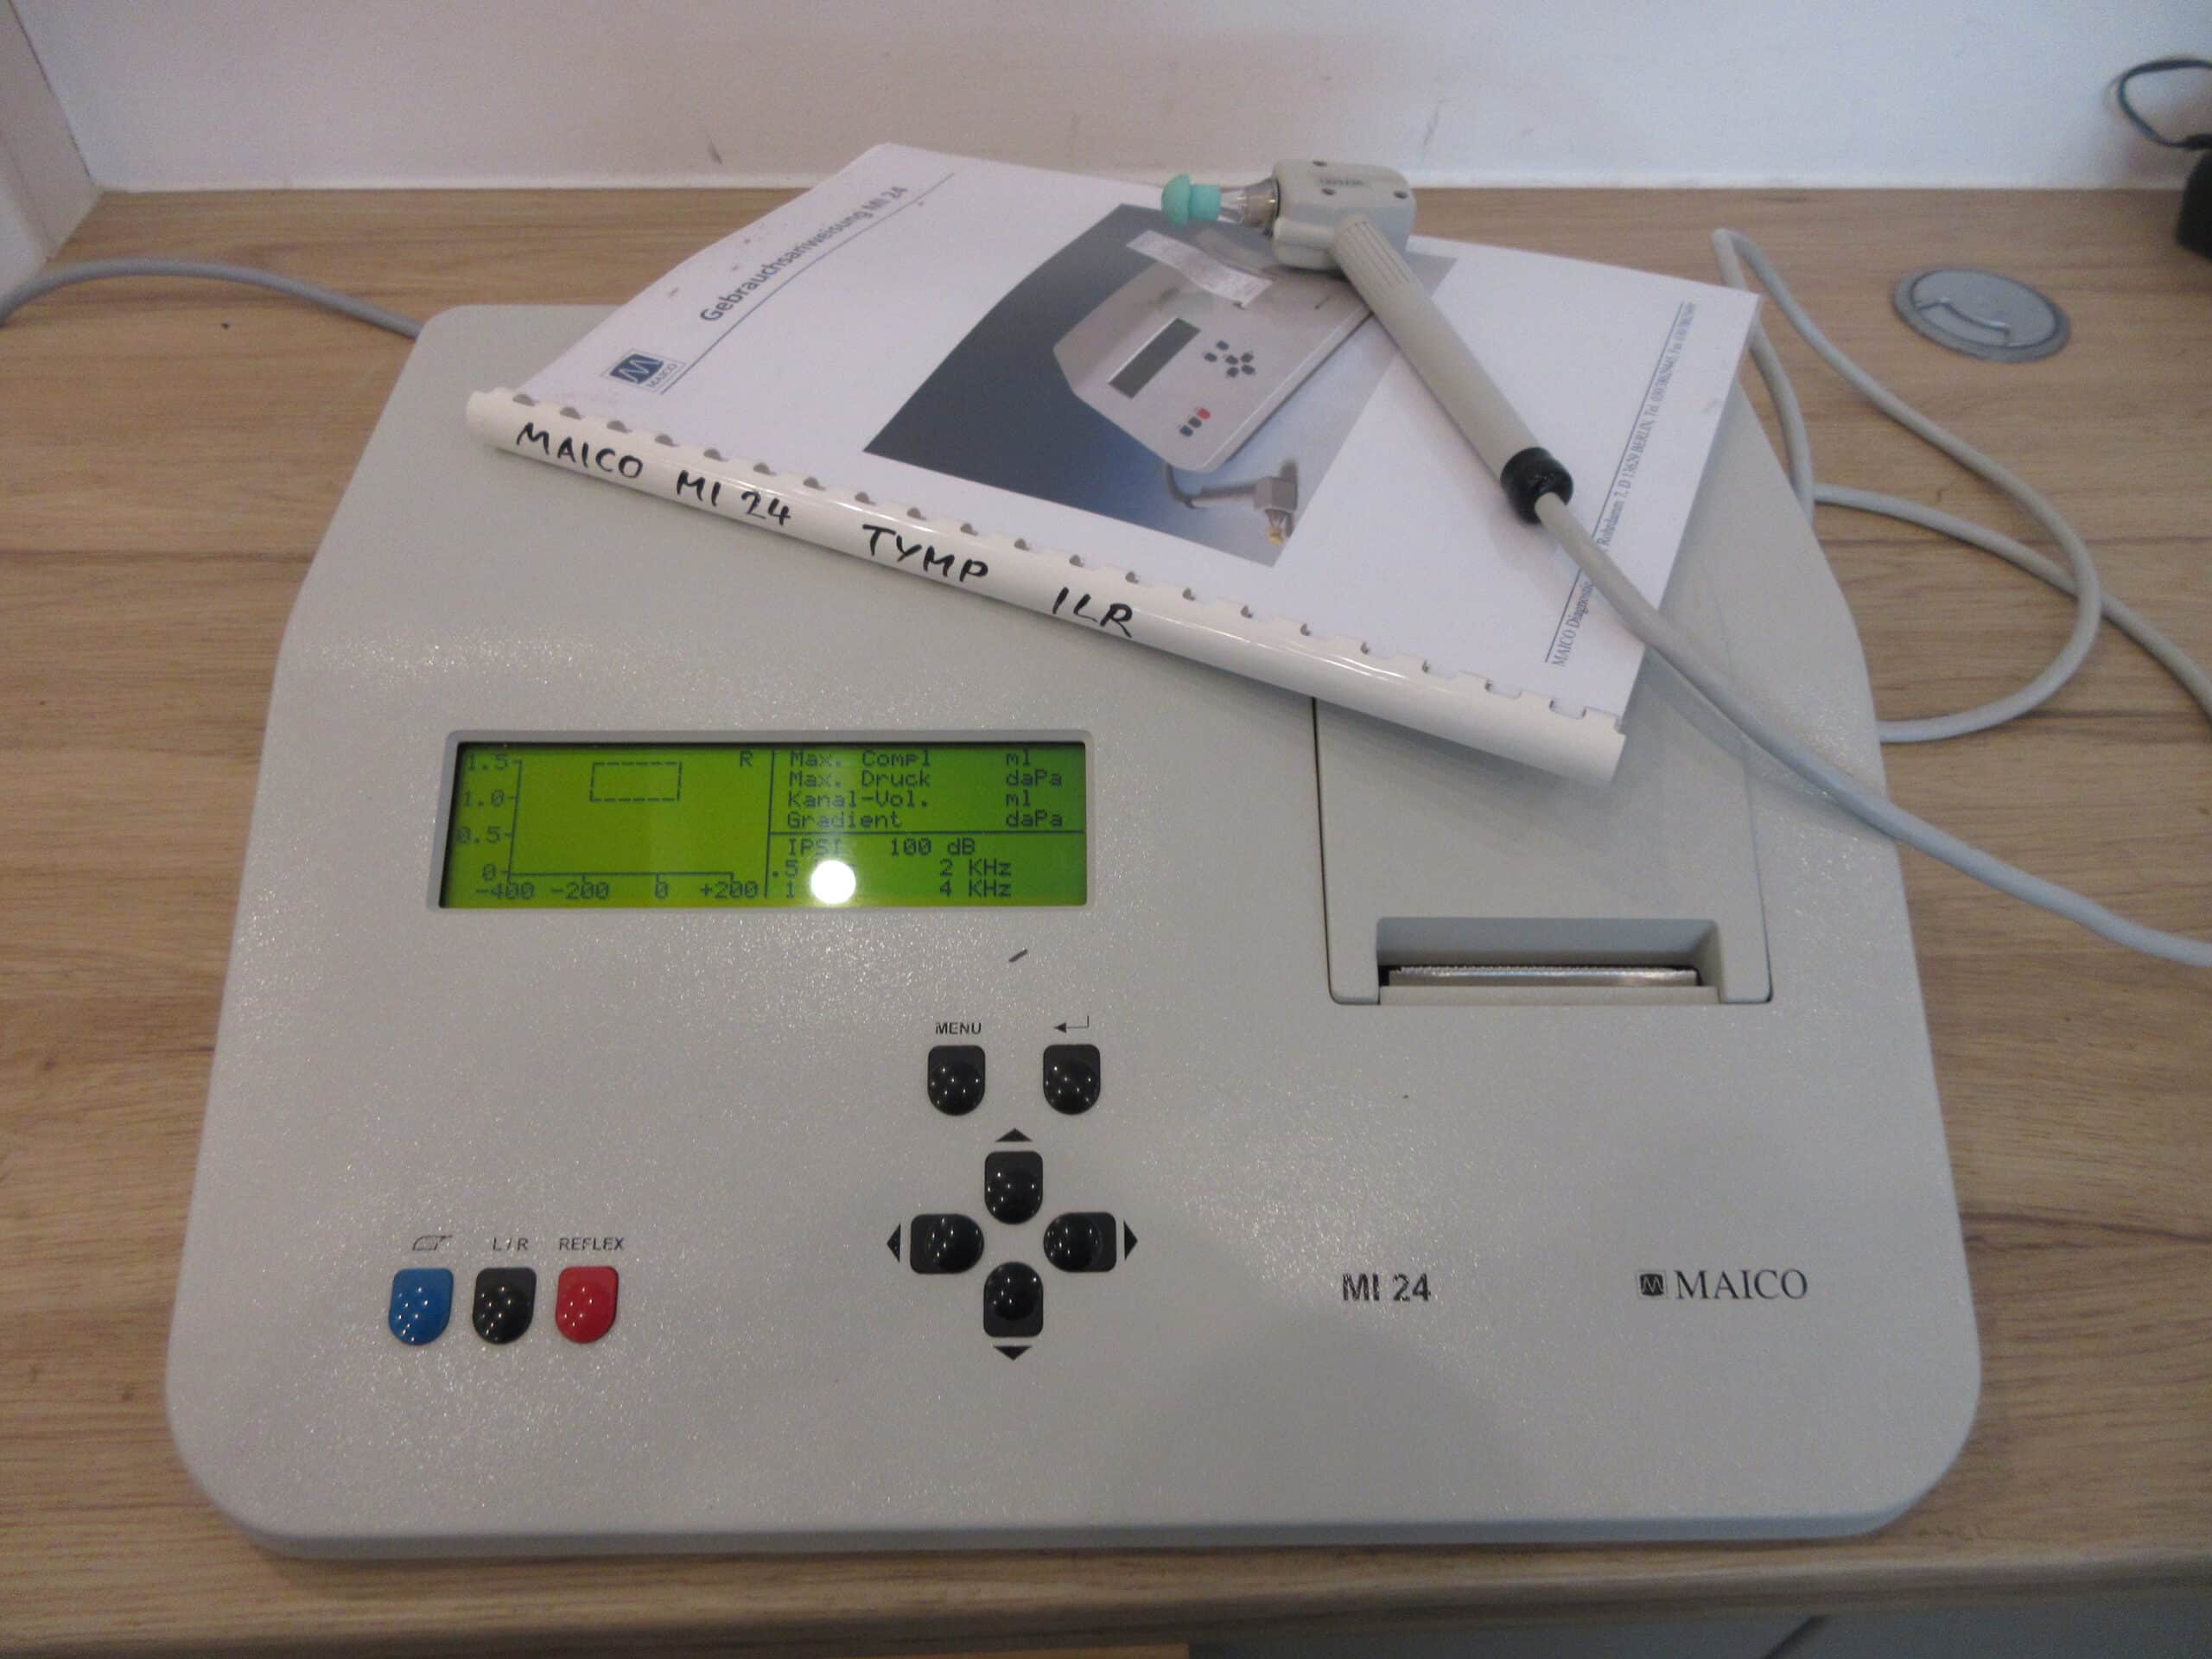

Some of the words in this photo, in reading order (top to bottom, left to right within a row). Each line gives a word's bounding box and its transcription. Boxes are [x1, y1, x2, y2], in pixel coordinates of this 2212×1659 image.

[700, 211, 873, 321] Gebrauchsanweisung
[516, 423, 643, 479] MAICO
[676, 470, 721, 506] MI
[741, 490, 791, 526] 24
[862, 524, 988, 582] TYMP
[1052, 587, 1133, 638] ILR
[1552, 629, 1577, 667] MAICO
[740, 750, 753, 767] R
[789, 750, 842, 767] Max.
[862, 749, 931, 767] Compl
[1006, 749, 1033, 766] ml
[789, 771, 842, 787] Max.
[861, 770, 931, 787] Druck
[1006, 769, 1063, 787] daPa
[461, 789, 505, 807] 1.0
[788, 790, 929, 808] Kanal-Vol.
[1006, 790, 1032, 807] ml
[788, 810, 902, 829] Gradient
[1006, 810, 1063, 828] daPa
[457, 826, 501, 843] 0.5
[788, 837, 842, 855] IPSI
[891, 838, 931, 855] 100
[947, 837, 976, 855] dB
[482, 864, 497, 881] 0
[939, 860, 954, 877] 2
[969, 860, 1011, 876] KHz
[474, 881, 535, 899] -400
[551, 881, 610, 899] -200
[655, 881, 669, 899] 0
[700, 881, 759, 899] +200
[785, 881, 797, 899] 1
[939, 880, 953, 897] 4
[969, 880, 1011, 897] KHz
[935, 1022, 982, 1035] MENU
[559, 1237, 625, 1251] REFLEX
[1342, 1273, 1380, 1302] MI
[1393, 1273, 1431, 1302] 24
[1675, 1268, 1808, 1300] MAICO
